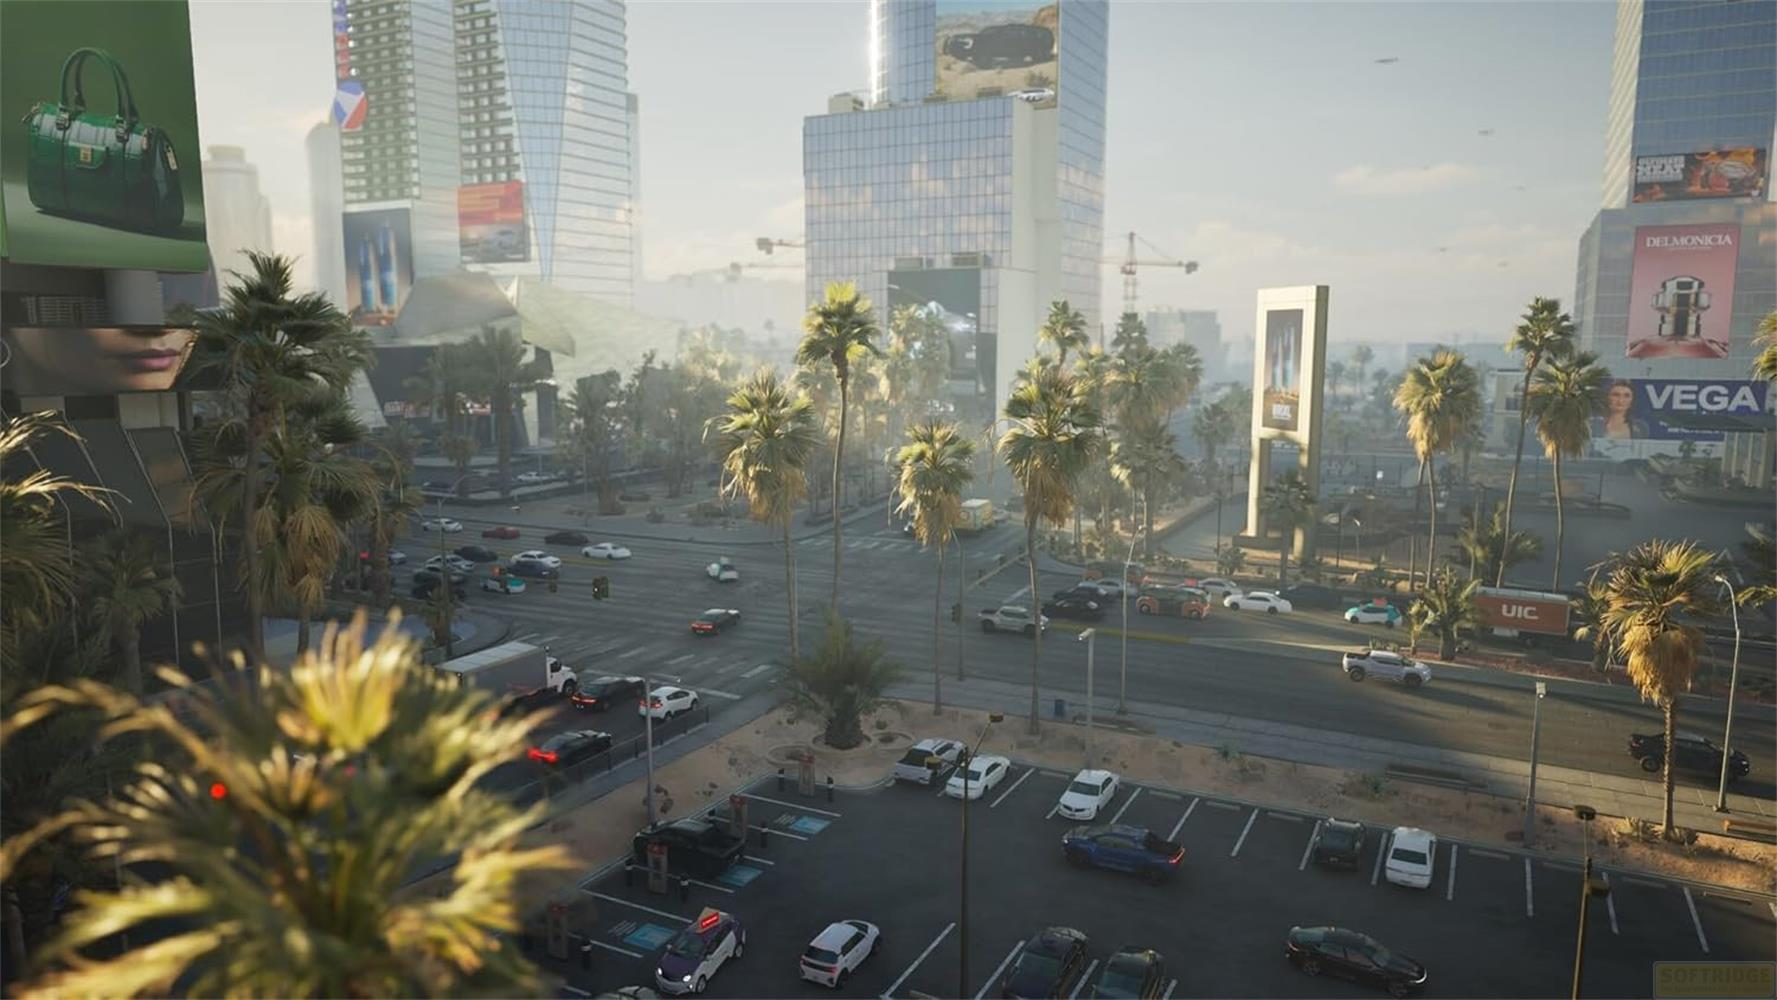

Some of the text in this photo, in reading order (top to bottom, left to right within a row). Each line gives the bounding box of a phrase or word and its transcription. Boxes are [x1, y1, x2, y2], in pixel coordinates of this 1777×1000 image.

[1646, 234, 1732, 247] DELMONICIA
[1645, 384, 1760, 411] VEGA
[1501, 603, 1539, 620] UIC
